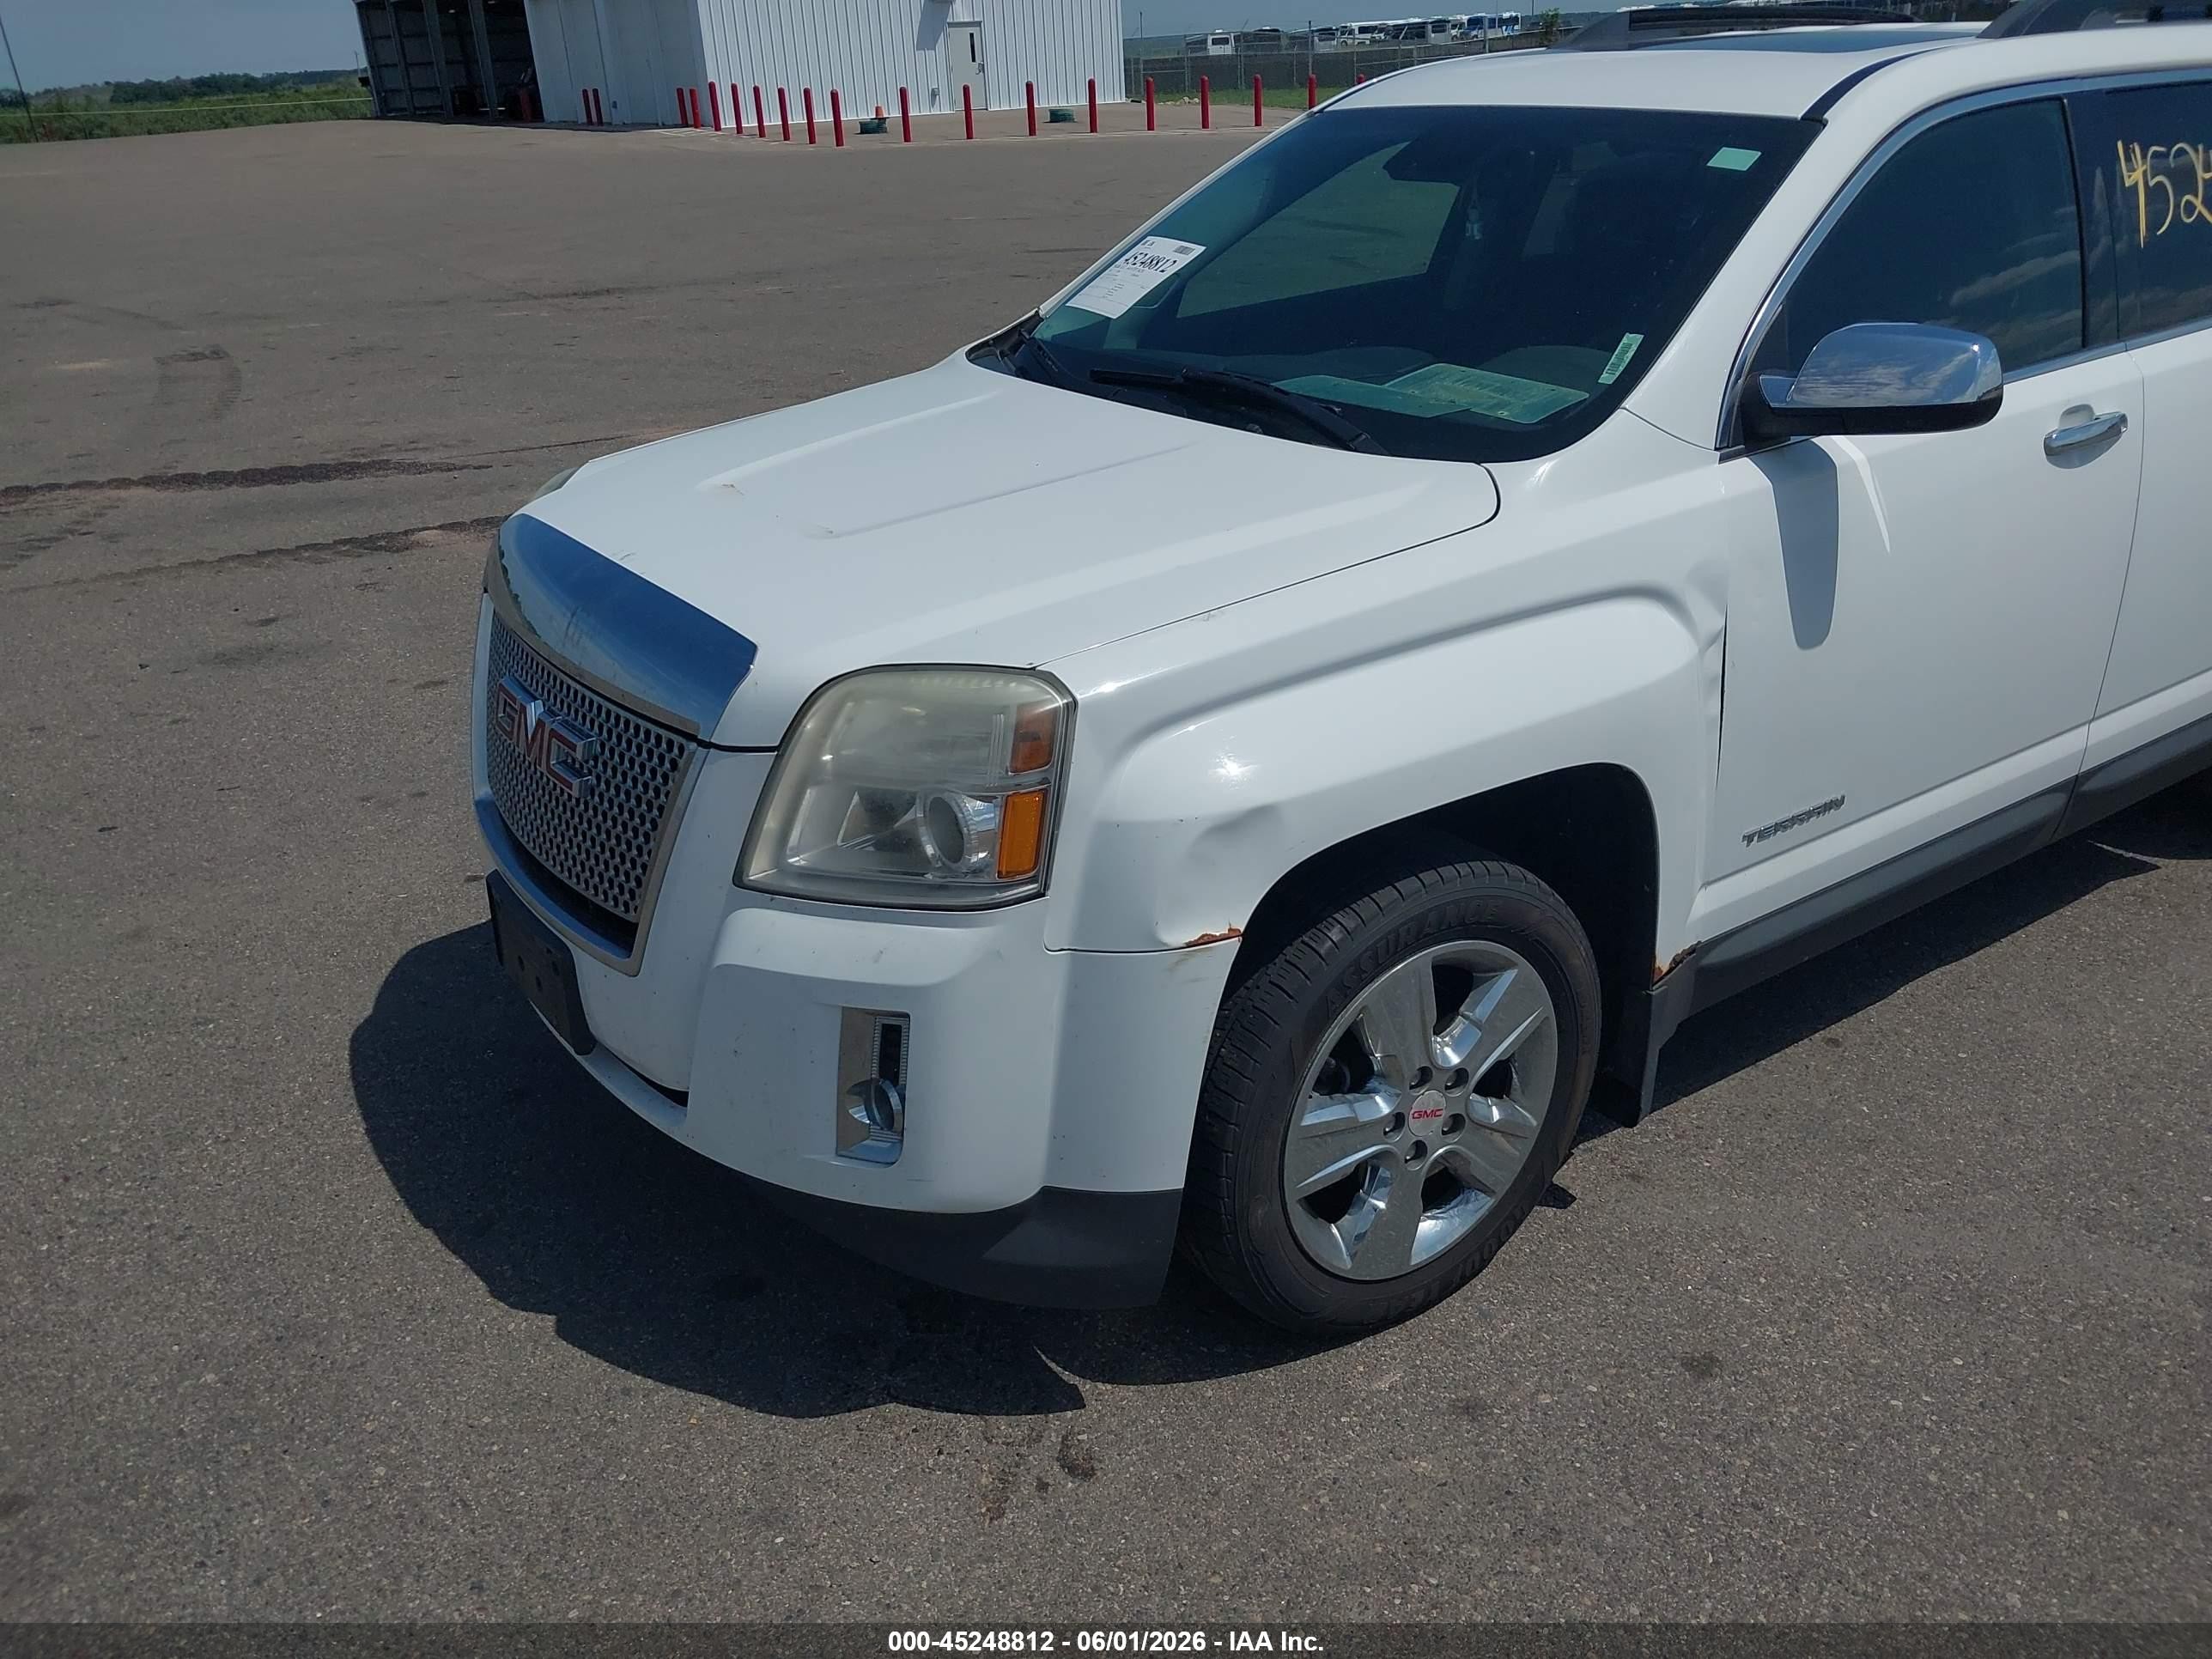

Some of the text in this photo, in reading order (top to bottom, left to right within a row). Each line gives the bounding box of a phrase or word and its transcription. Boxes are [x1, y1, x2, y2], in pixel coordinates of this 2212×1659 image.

[495, 676, 598, 798] GMC
[1741, 794, 1845, 848] TERRAIN
[1319, 897, 1504, 1017] ASSURANCE
[1412, 1108, 1443, 1120] GMC
